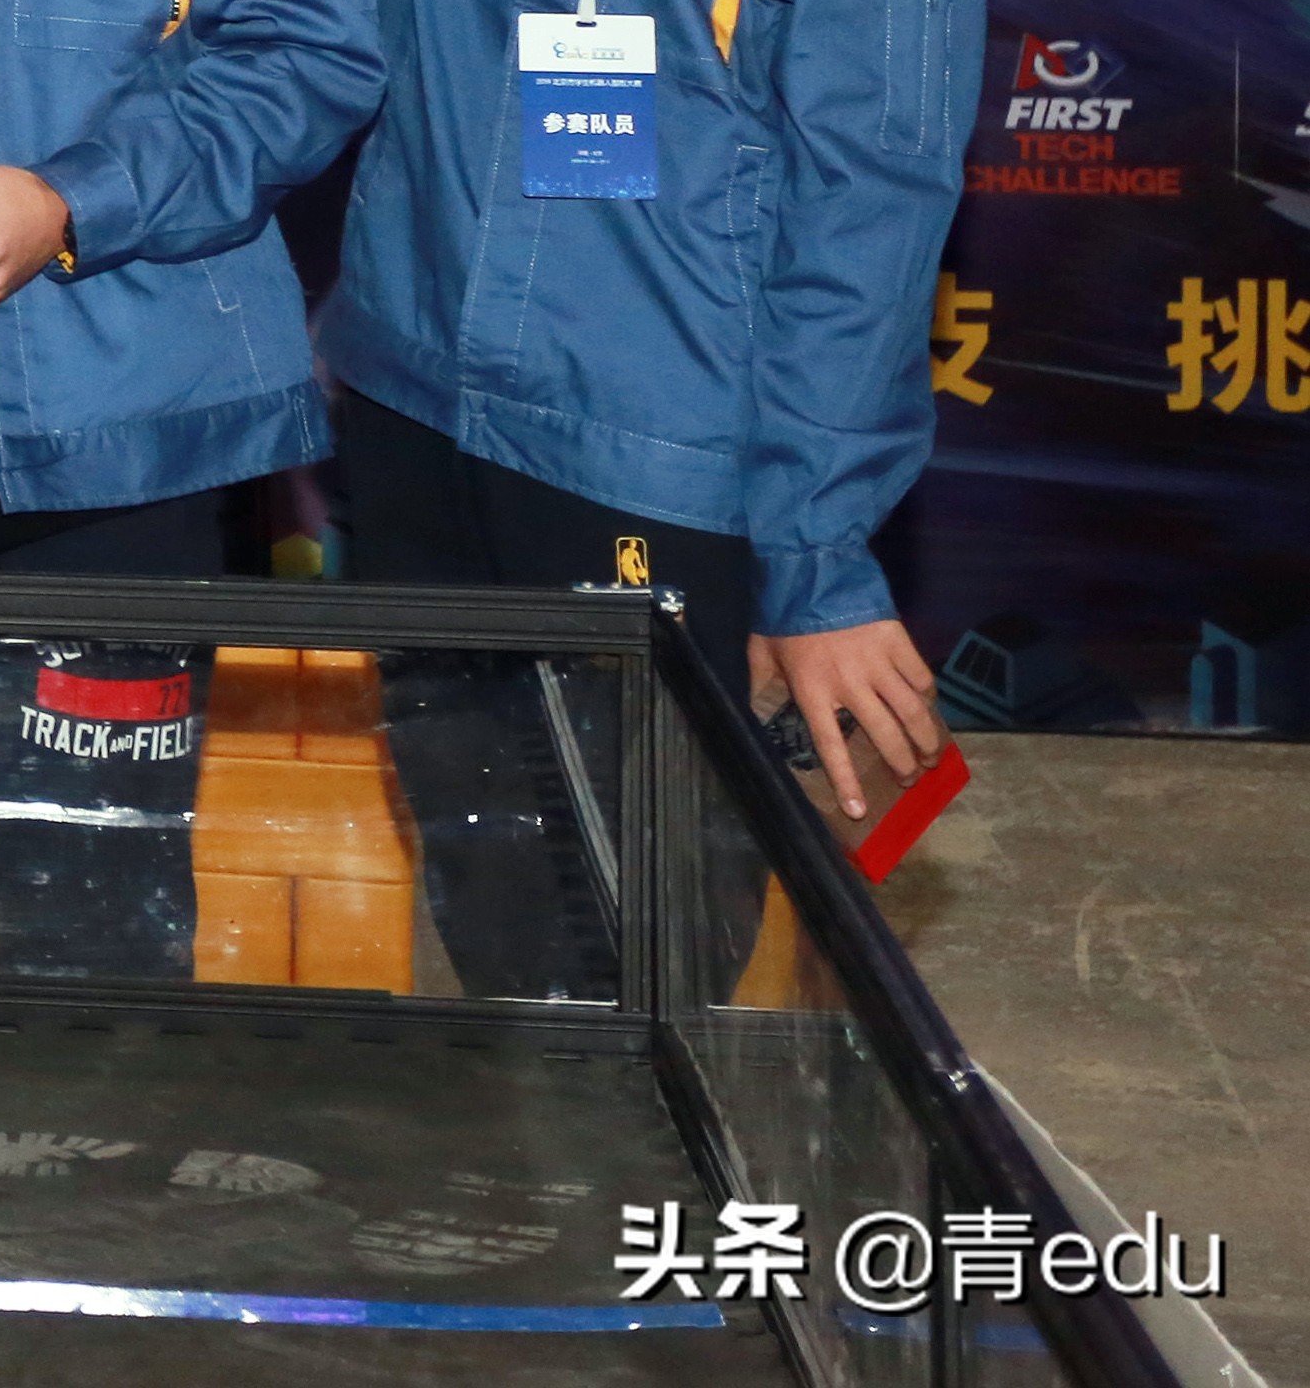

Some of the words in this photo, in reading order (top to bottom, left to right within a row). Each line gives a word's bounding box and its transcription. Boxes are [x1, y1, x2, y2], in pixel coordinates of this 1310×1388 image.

[543, 112, 635, 135] 参赛队员
[1004, 97, 1133, 130] FIRST
[1015, 134, 1115, 161] TECH
[964, 166, 1182, 196] CHALLENGE
[20, 705, 111, 759] TRACK
